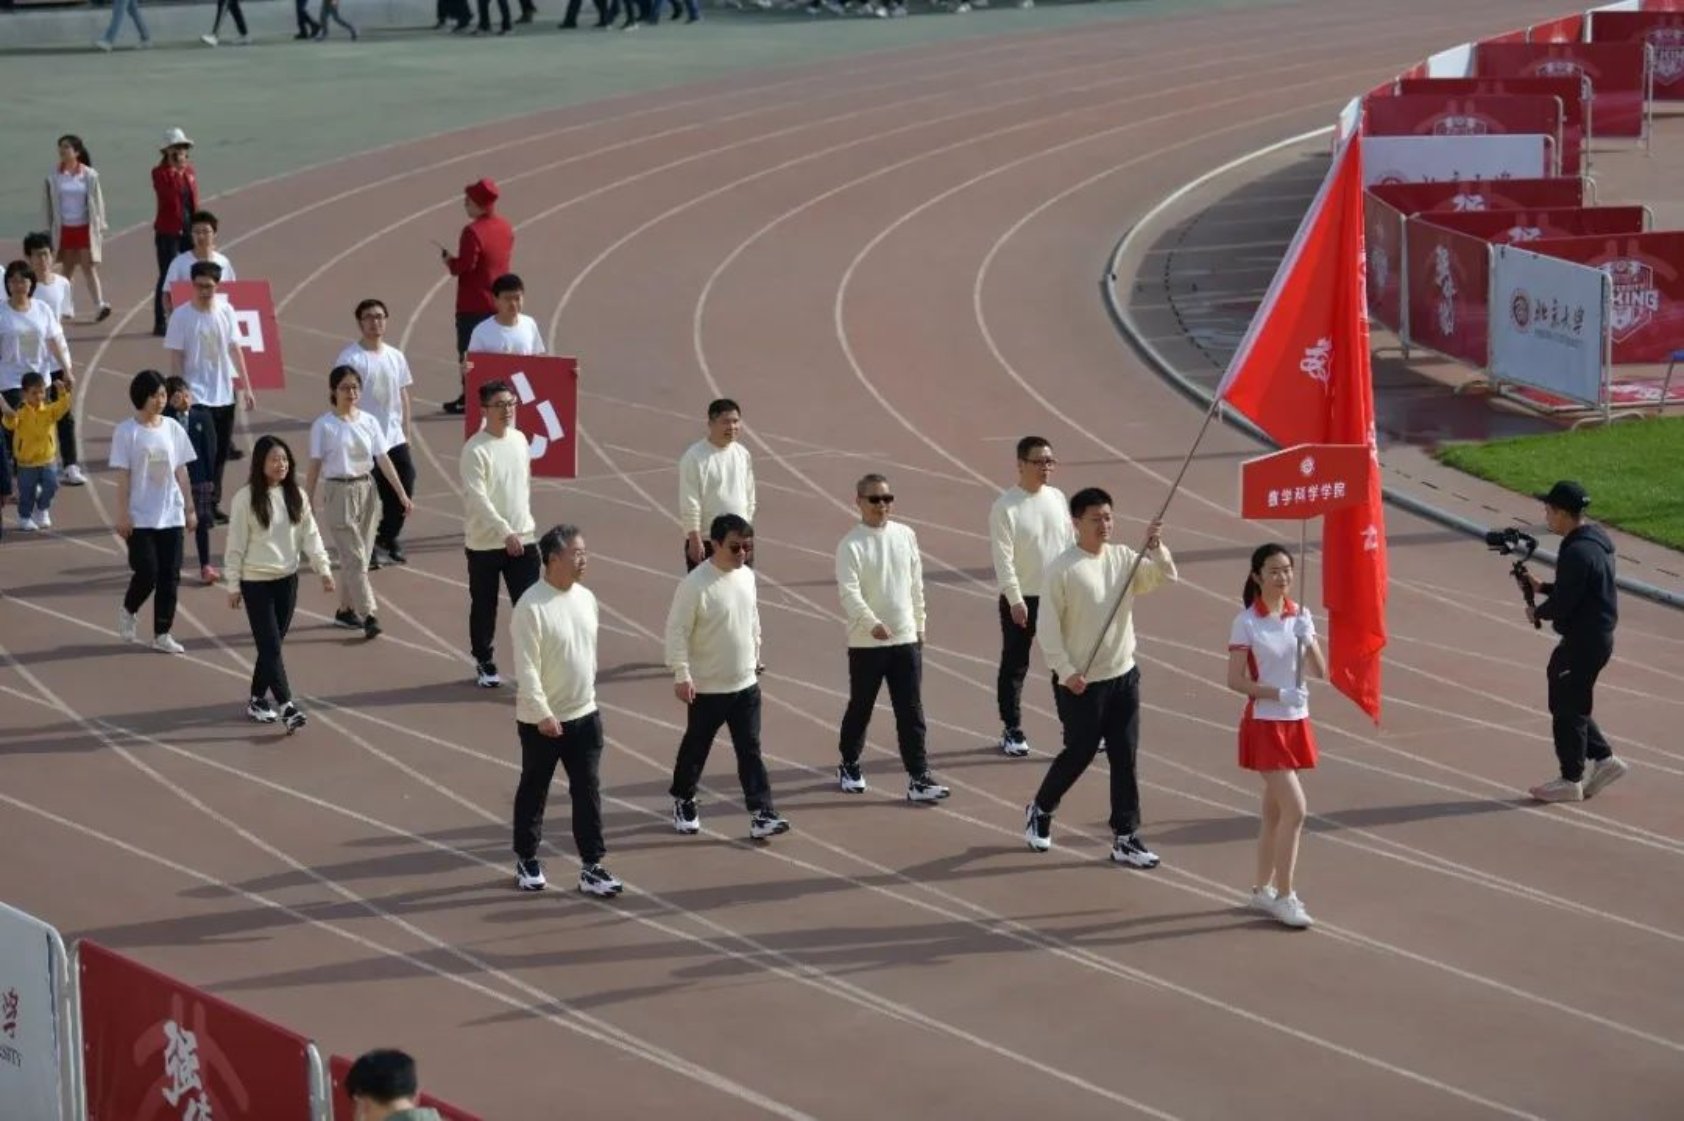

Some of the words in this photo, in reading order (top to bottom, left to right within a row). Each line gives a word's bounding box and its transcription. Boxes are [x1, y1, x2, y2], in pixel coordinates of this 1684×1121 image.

[1534, 298, 1584, 335] 北京大学
[1267, 482, 1346, 508] 数学科学学院
